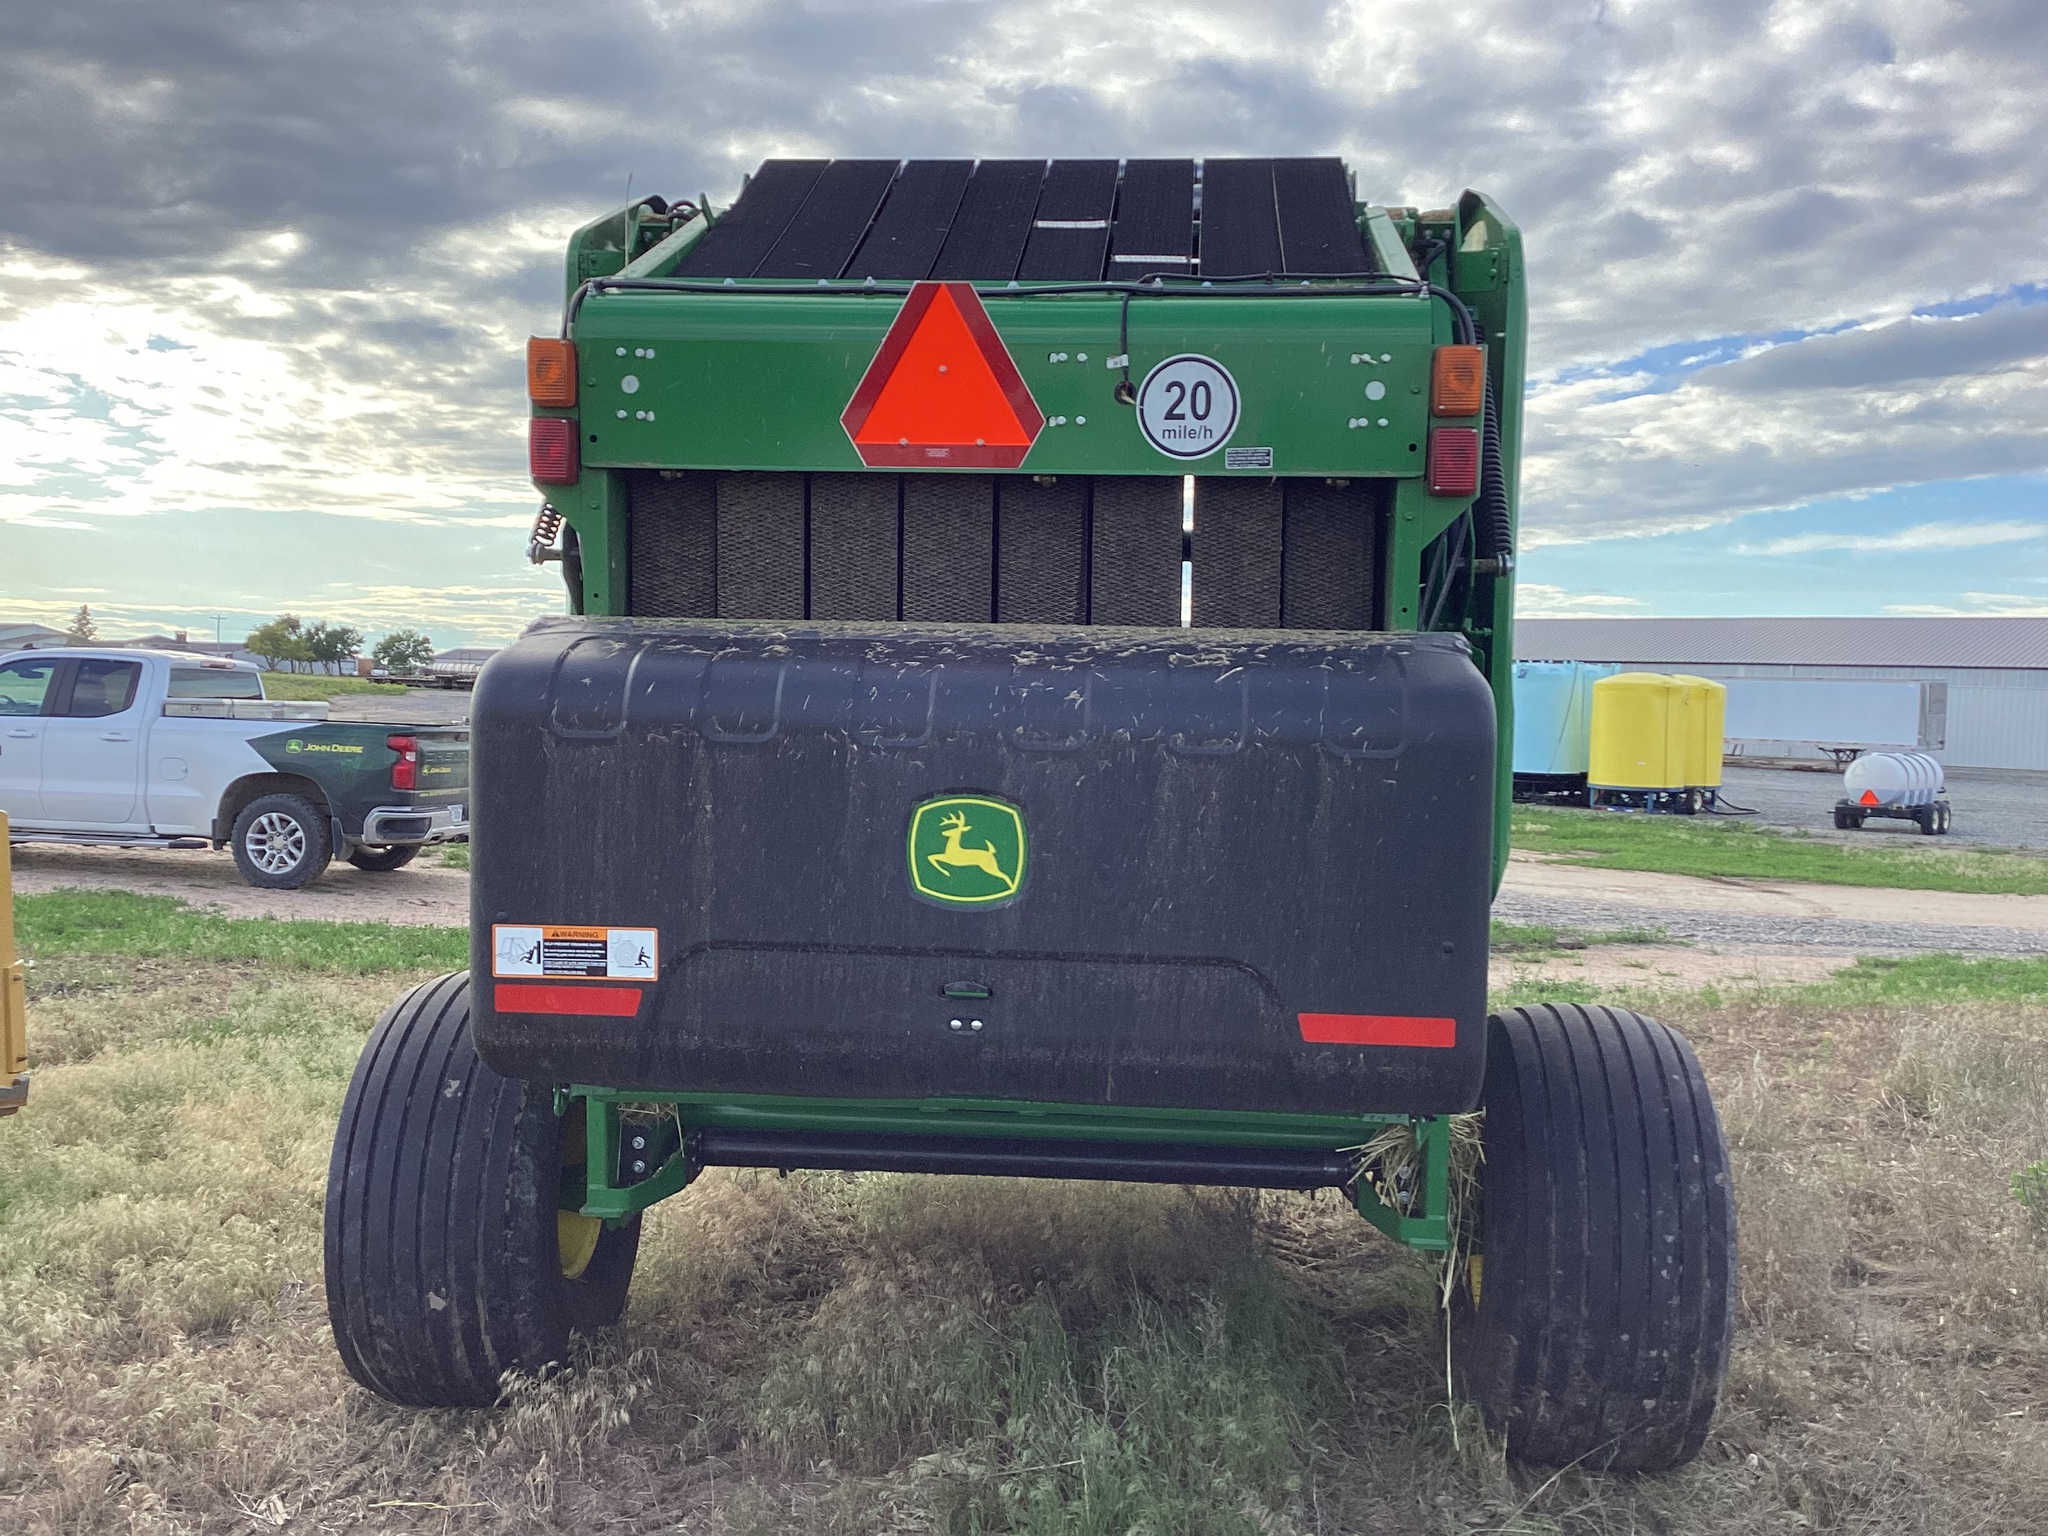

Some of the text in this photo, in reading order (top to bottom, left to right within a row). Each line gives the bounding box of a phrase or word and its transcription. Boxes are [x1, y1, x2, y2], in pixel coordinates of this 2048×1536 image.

[1163, 380, 1212, 421] 20
[1162, 425, 1213, 440] mile/h
[304, 743, 364, 753] JOHN DEERE
